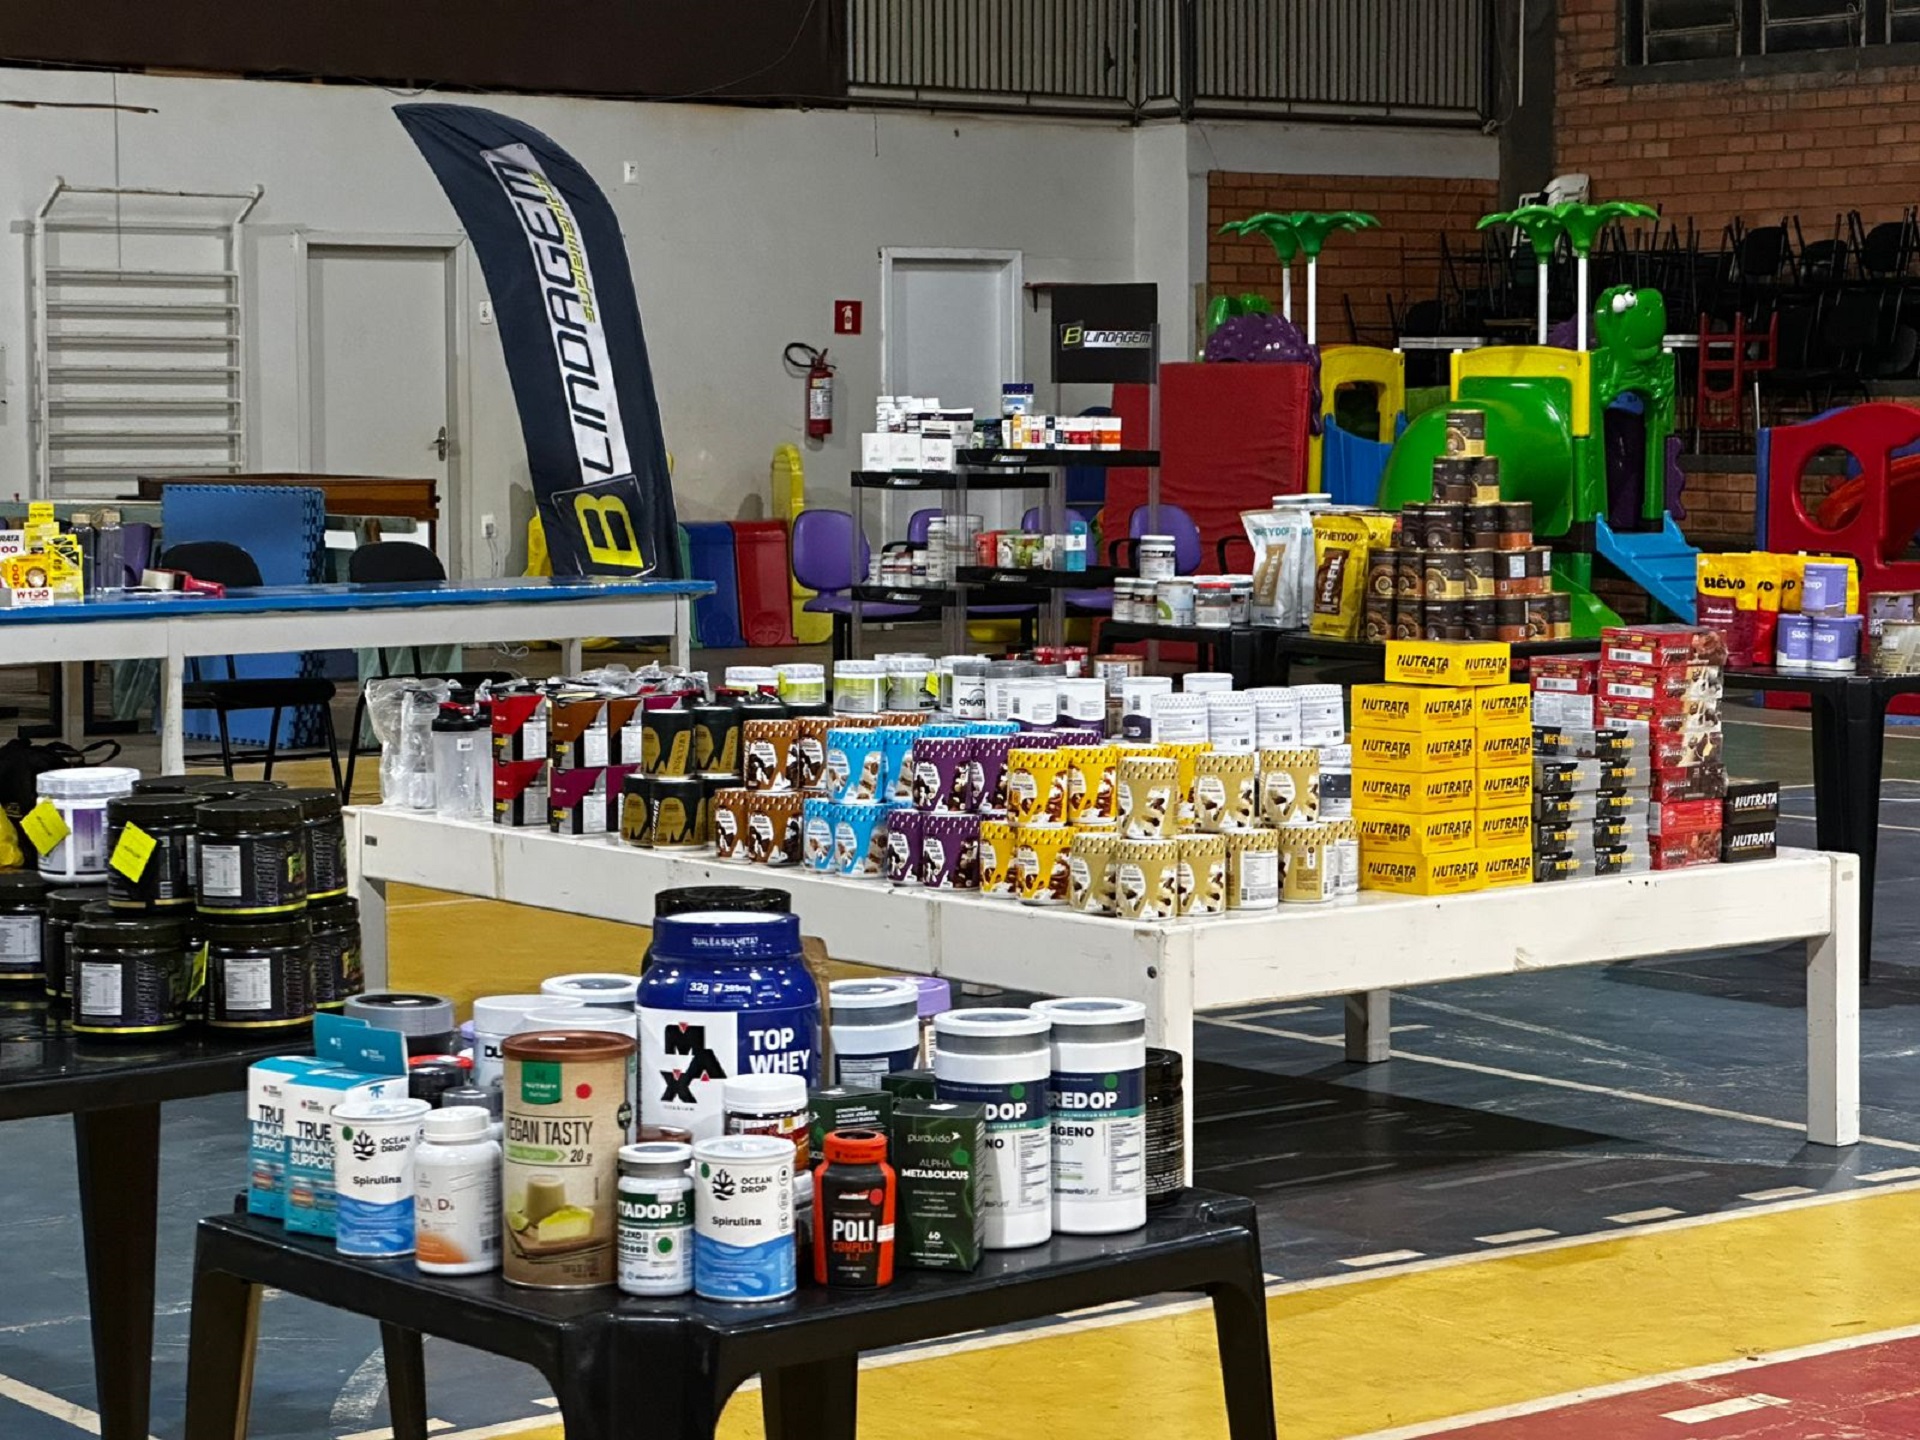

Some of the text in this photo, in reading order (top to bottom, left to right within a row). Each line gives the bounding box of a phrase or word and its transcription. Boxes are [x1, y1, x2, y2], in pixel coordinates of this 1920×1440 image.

[1397, 654, 1449, 669] NUTRATA
[1465, 657, 1507, 670] NUTRATA
[1362, 698, 1410, 713] NUTRATA
[1424, 698, 1472, 714] NUTRATA
[1482, 696, 1528, 710] NUTRATA
[1362, 739, 1411, 754] NUTRATA
[1426, 739, 1472, 754] NUTRATA
[1484, 737, 1530, 751] NUTRATA
[1362, 781, 1411, 795] NUTRATA
[1427, 780, 1472, 796] NUTRATA
[1484, 776, 1530, 791] NUTRATA
[1735, 792, 1777, 809] NUTRATA
[1361, 822, 1411, 836] NUTRATA
[1427, 821, 1472, 836] NUTRATA
[1483, 816, 1529, 832] NUTRATA
[1732, 832, 1775, 848] NUTRATA
[1368, 862, 1416, 877] NUTRATA
[1432, 862, 1479, 877] NUTRATA
[1486, 857, 1530, 873] NUTRATA
[689, 982, 709, 995] 32g
[748, 1027, 794, 1051] TOP
[749, 1049, 811, 1075] WHEY
[1047, 1091, 1118, 1109] REDOP
[259, 1104, 284, 1124] TRU
[985, 1102, 1027, 1120] DOP
[253, 1121, 284, 1138] IMMUN
[296, 1120, 332, 1142] TRUE
[508, 1117, 593, 1145] EGAN TASTY
[1050, 1122, 1094, 1137] ÁGENO
[252, 1135, 285, 1152] SUPPO
[381, 1136, 410, 1146] OCEAN
[381, 1144, 407, 1152] DROP
[985, 1138, 1004, 1149] NO
[290, 1152, 334, 1170] SUPPOR
[570, 1148, 593, 1165] 20 g
[919, 1158, 951, 1168] ALPHA
[353, 1176, 402, 1187] Spirulina
[741, 1177, 772, 1185] OCEAN
[901, 1168, 969, 1180] METABOLICUS
[741, 1185, 767, 1194] DROP
[618, 1200, 686, 1219] TADOP B
[712, 1216, 762, 1228] Spirulina
[833, 1219, 875, 1242] POLI
[832, 1241, 874, 1253] COMPLEX
